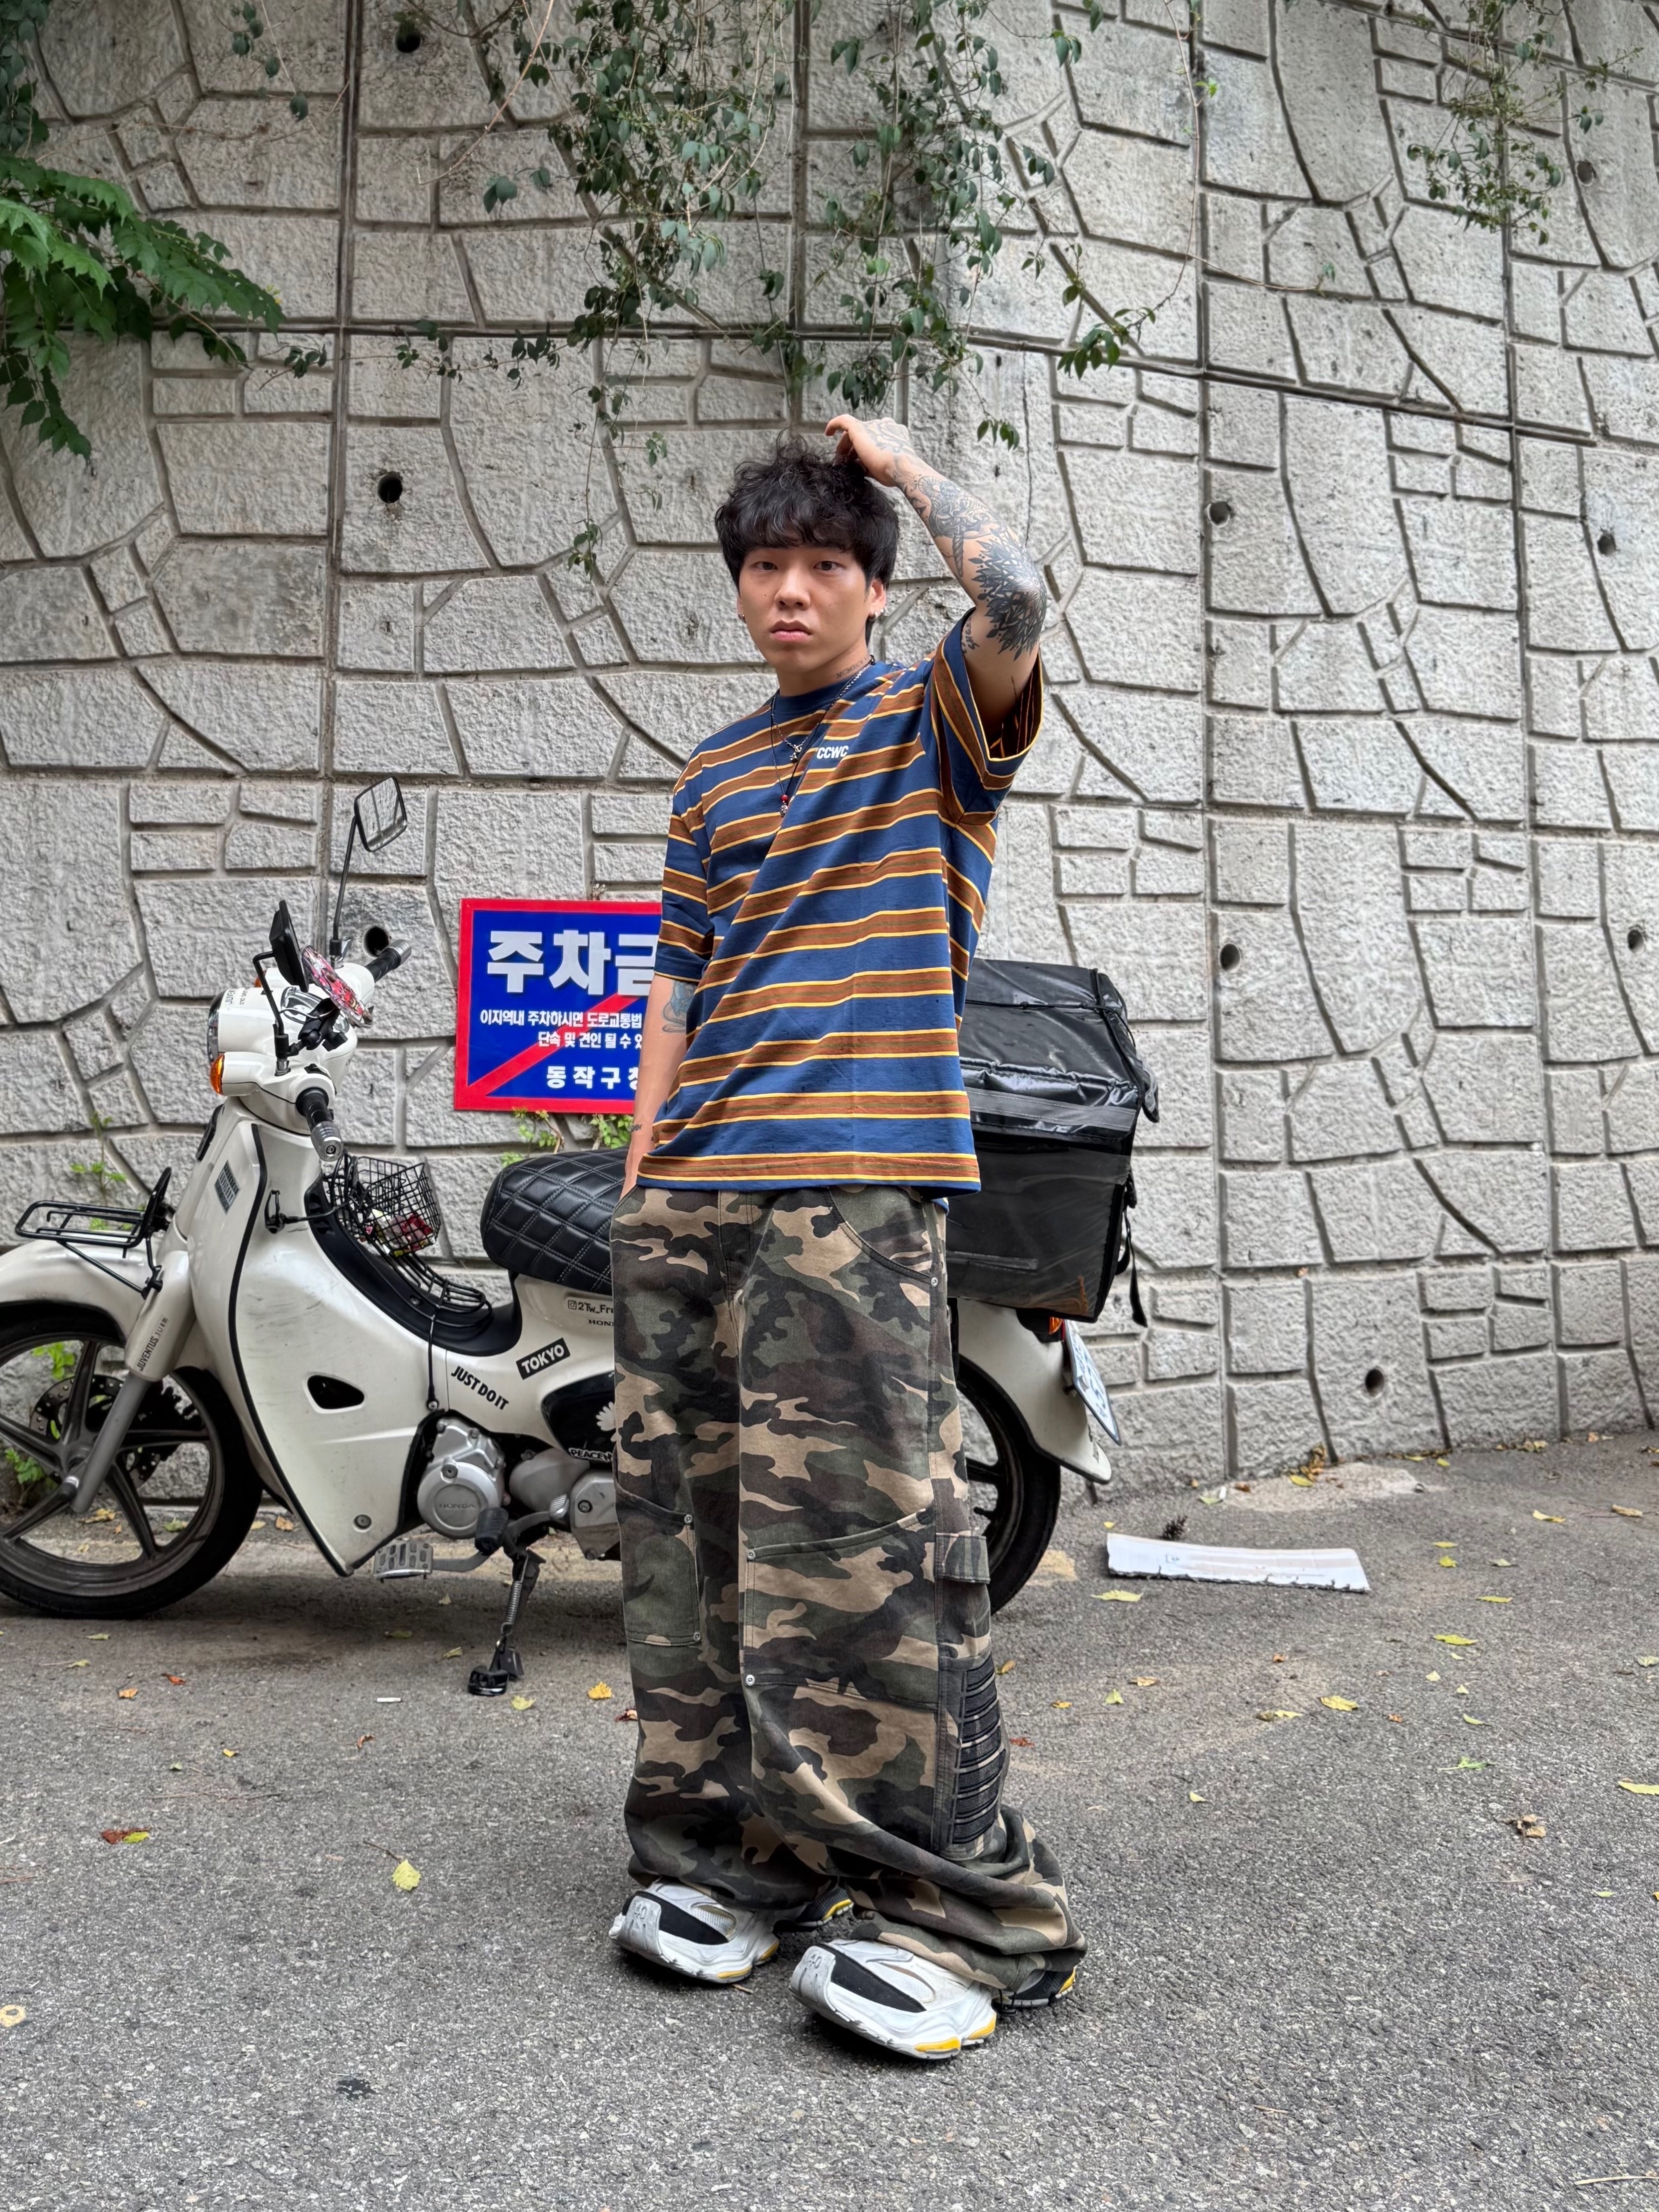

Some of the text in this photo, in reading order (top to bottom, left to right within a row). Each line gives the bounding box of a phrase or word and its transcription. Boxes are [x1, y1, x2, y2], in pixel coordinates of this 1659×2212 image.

[816, 745, 849, 759] CCWC
[480, 1010, 642, 1029] 이지역내 주차하시면 도로교통법
[538, 1031, 561, 1047] 단속
[564, 1032, 575, 1047] 및
[579, 1032, 601, 1048] 견인
[605, 1033, 616, 1048] 될
[619, 1033, 631, 1049] 수
[137, 1336, 159, 1372] JUVENTUS
[521, 1344, 565, 1373] TOKYO
[451, 1366, 509, 1411] JUST DO IT
